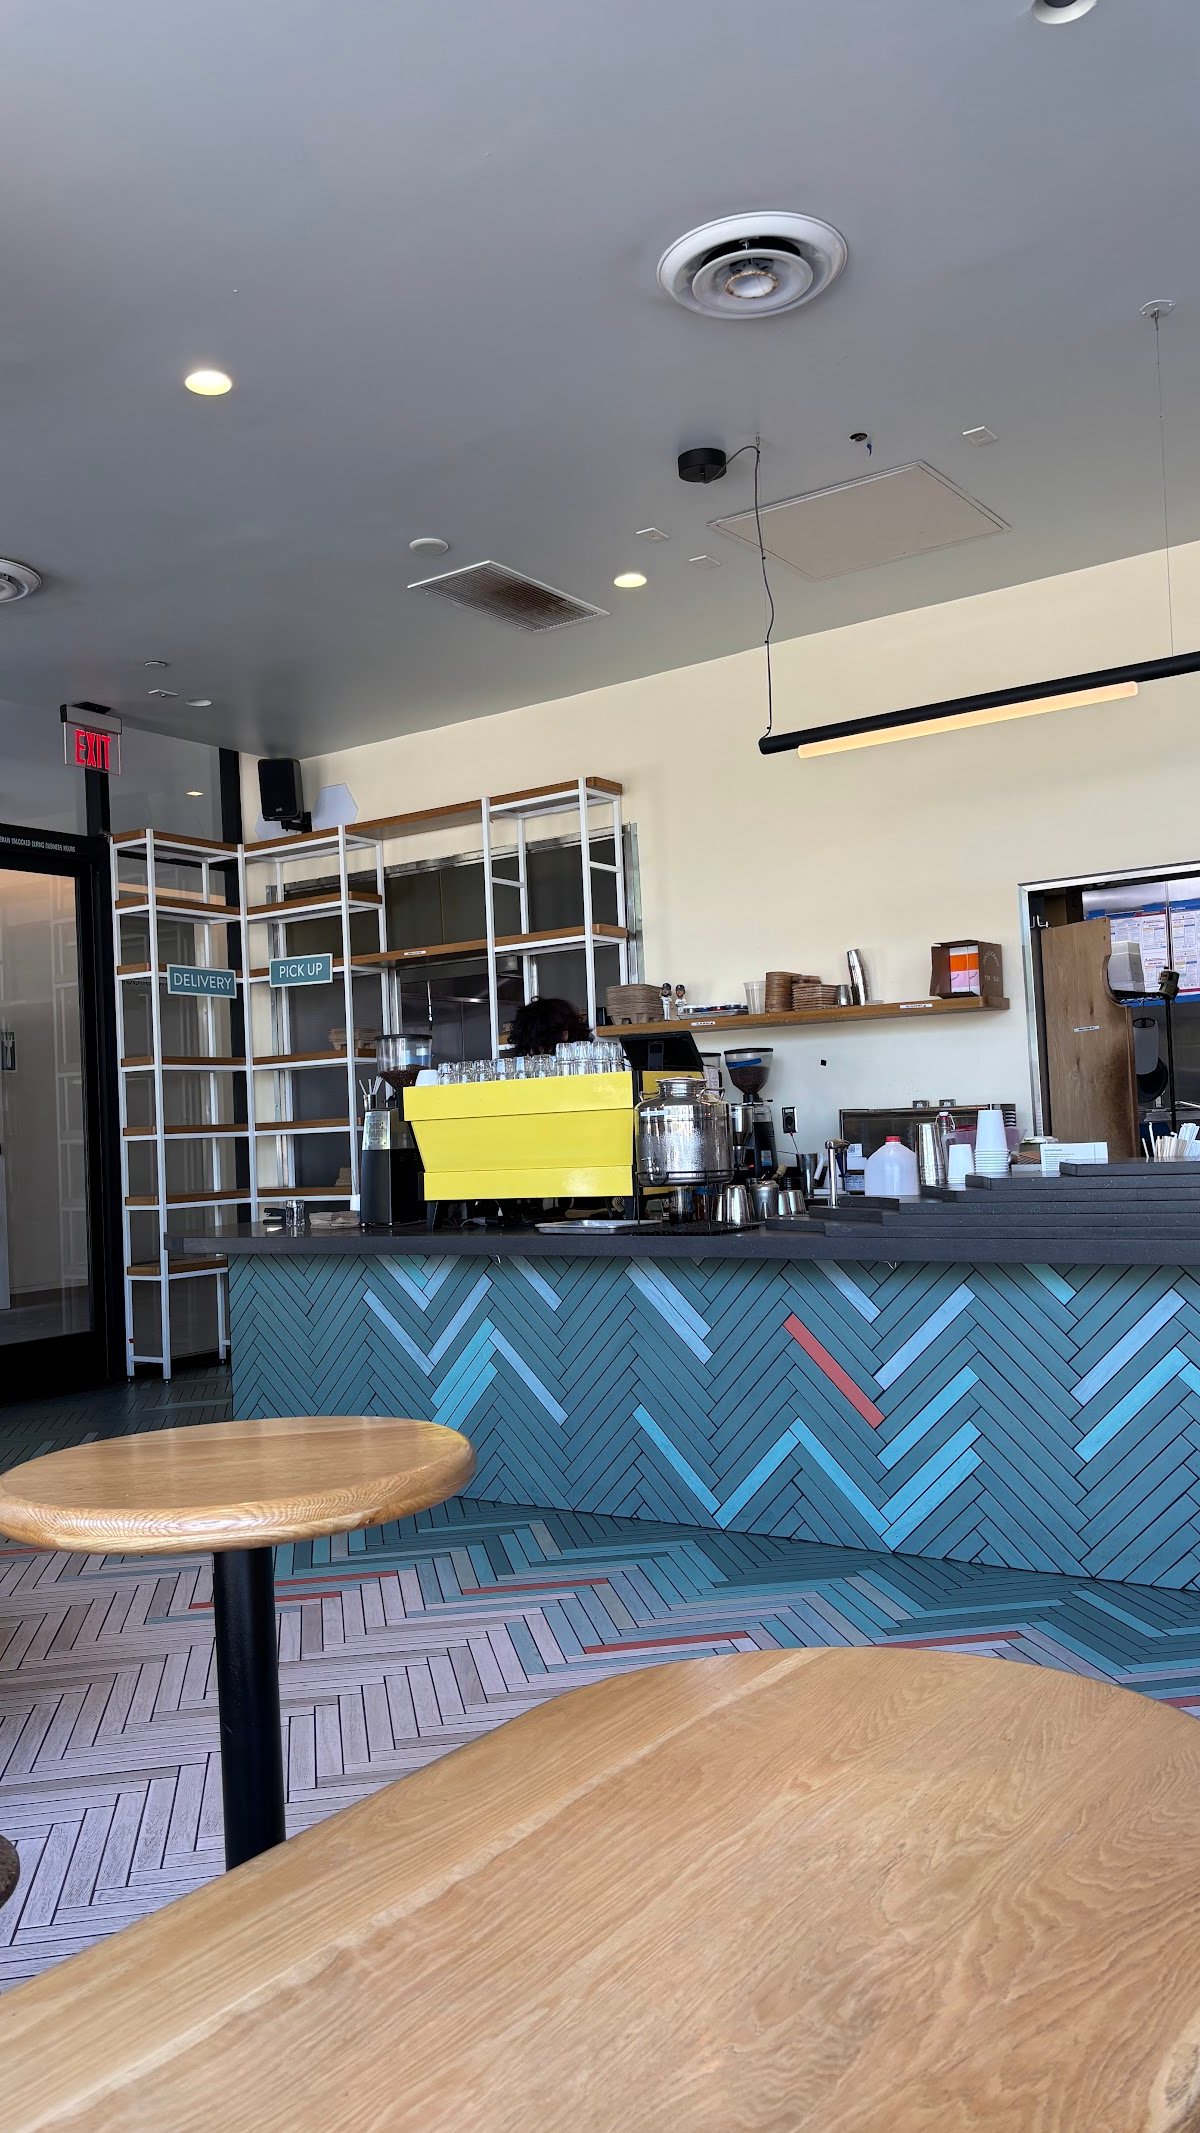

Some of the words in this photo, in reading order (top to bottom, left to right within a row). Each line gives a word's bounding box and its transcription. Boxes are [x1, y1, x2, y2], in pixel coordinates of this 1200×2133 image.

[75, 729, 111, 770] EXIT
[11, 838, 30, 847] UNLOCKED
[31, 840, 44, 849] DURING
[45, 842, 62, 851] BUSINESS
[63, 845, 76, 853] HOURS
[279, 964, 305, 978] PICK
[307, 962, 323, 976] UP
[173, 972, 232, 991] DELIVERY
